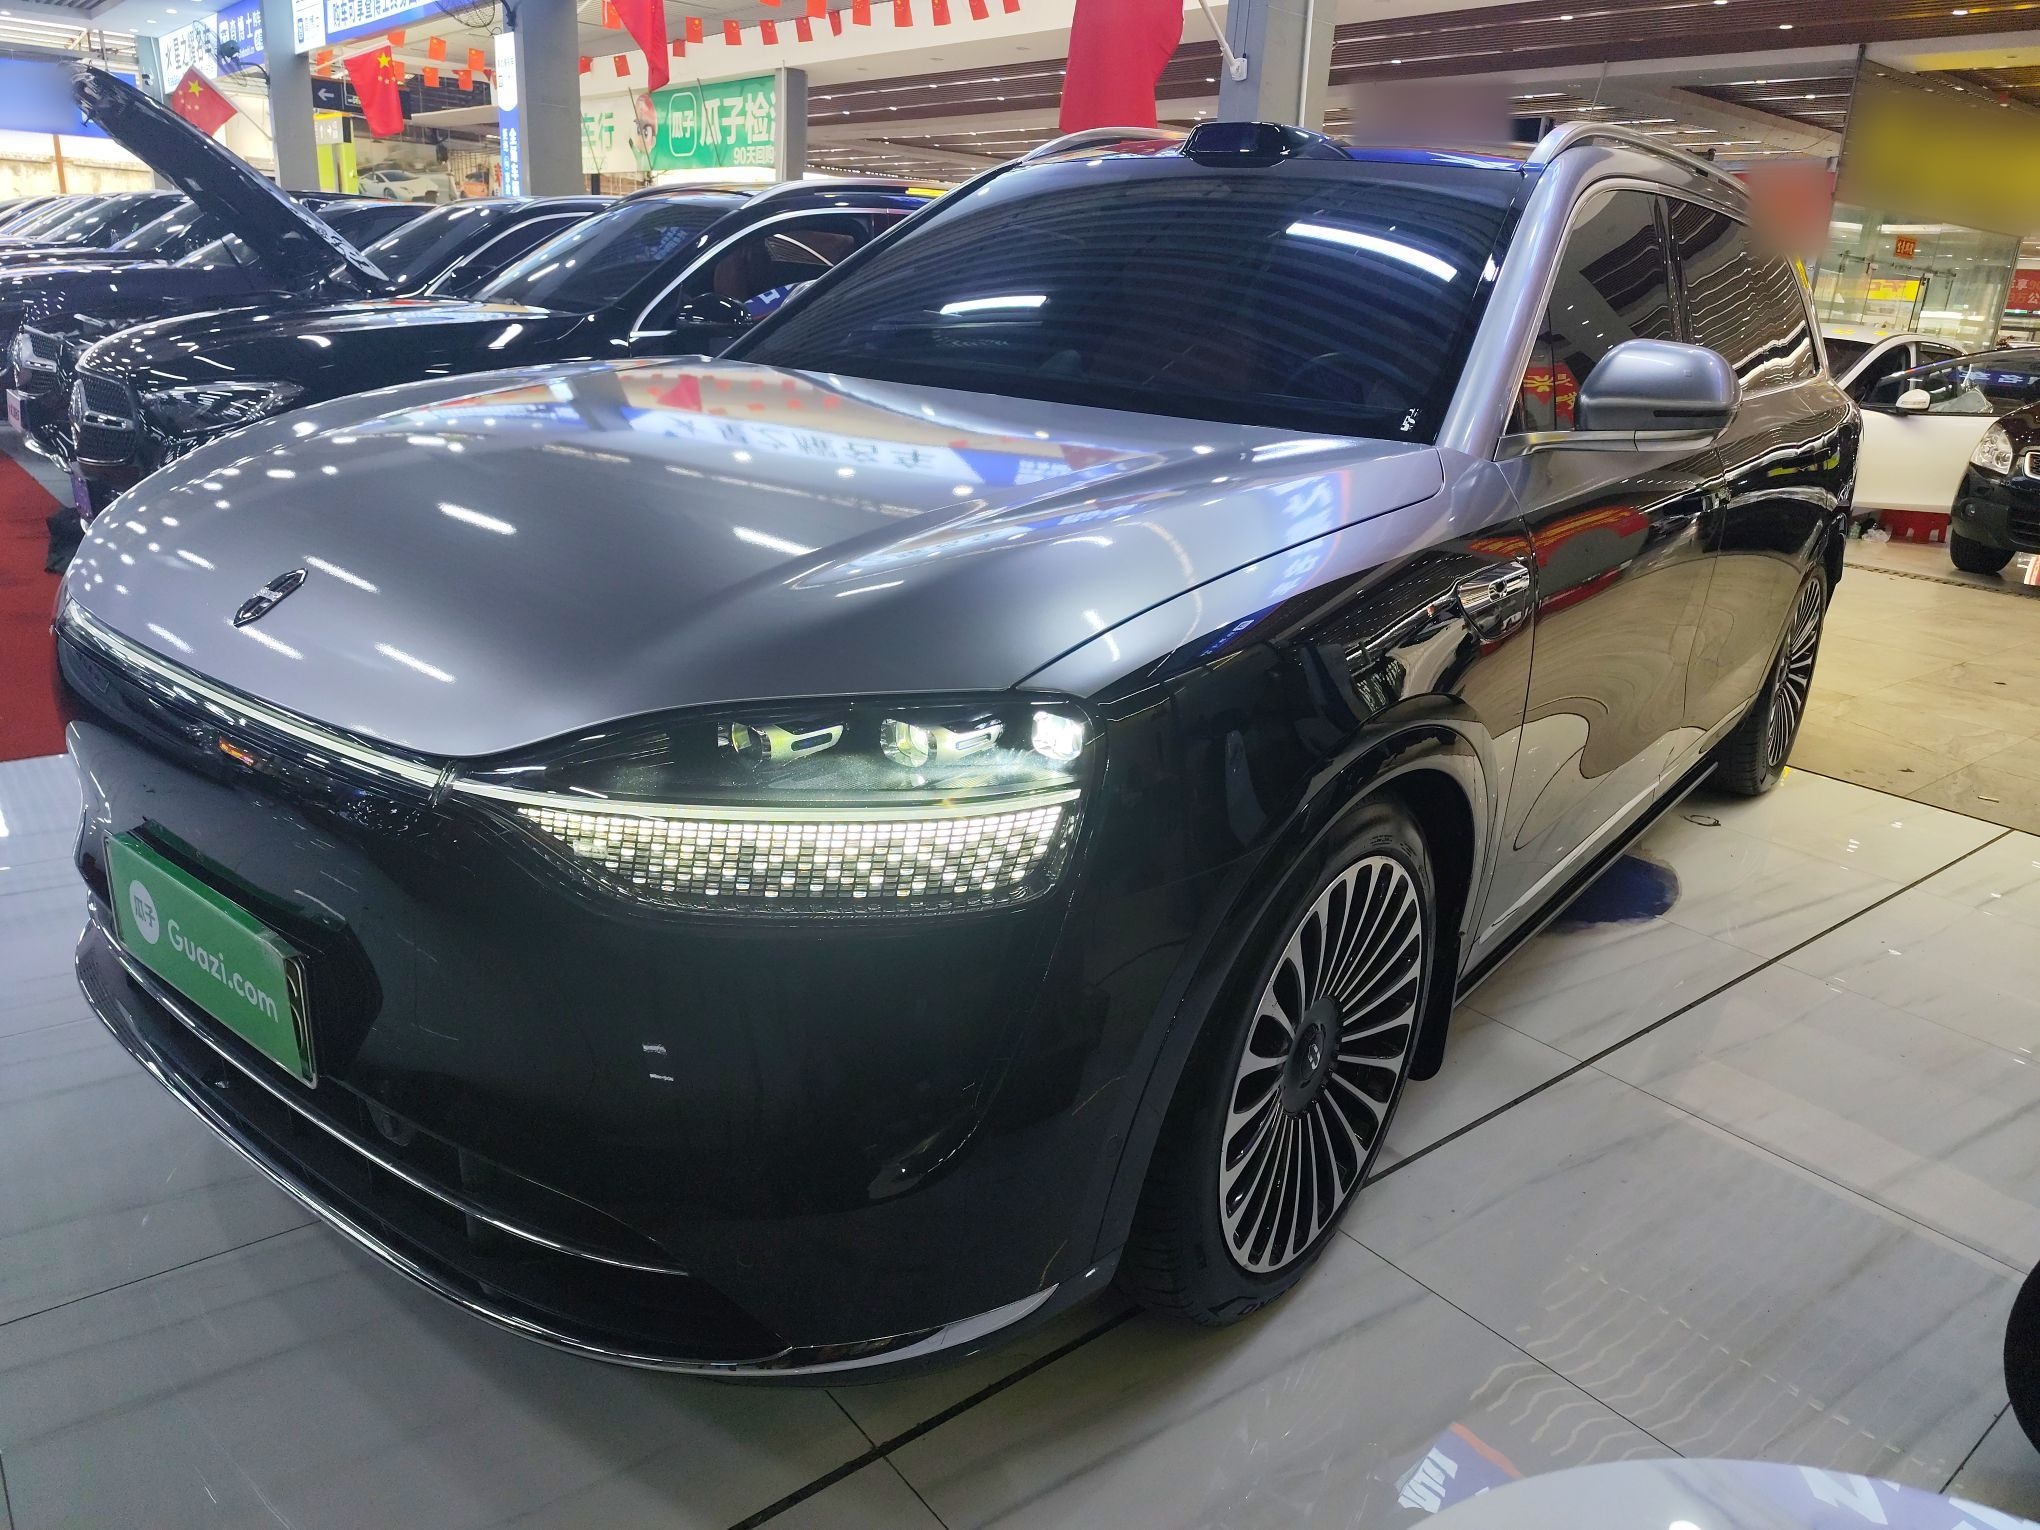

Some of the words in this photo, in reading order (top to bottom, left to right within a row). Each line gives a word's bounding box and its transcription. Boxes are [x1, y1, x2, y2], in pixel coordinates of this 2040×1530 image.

[671, 110, 695, 139] 瓜子
[699, 91, 775, 145] 瓜子检
[133, 895, 156, 929] 瓜子
[167, 918, 279, 1024] Guazi.com
